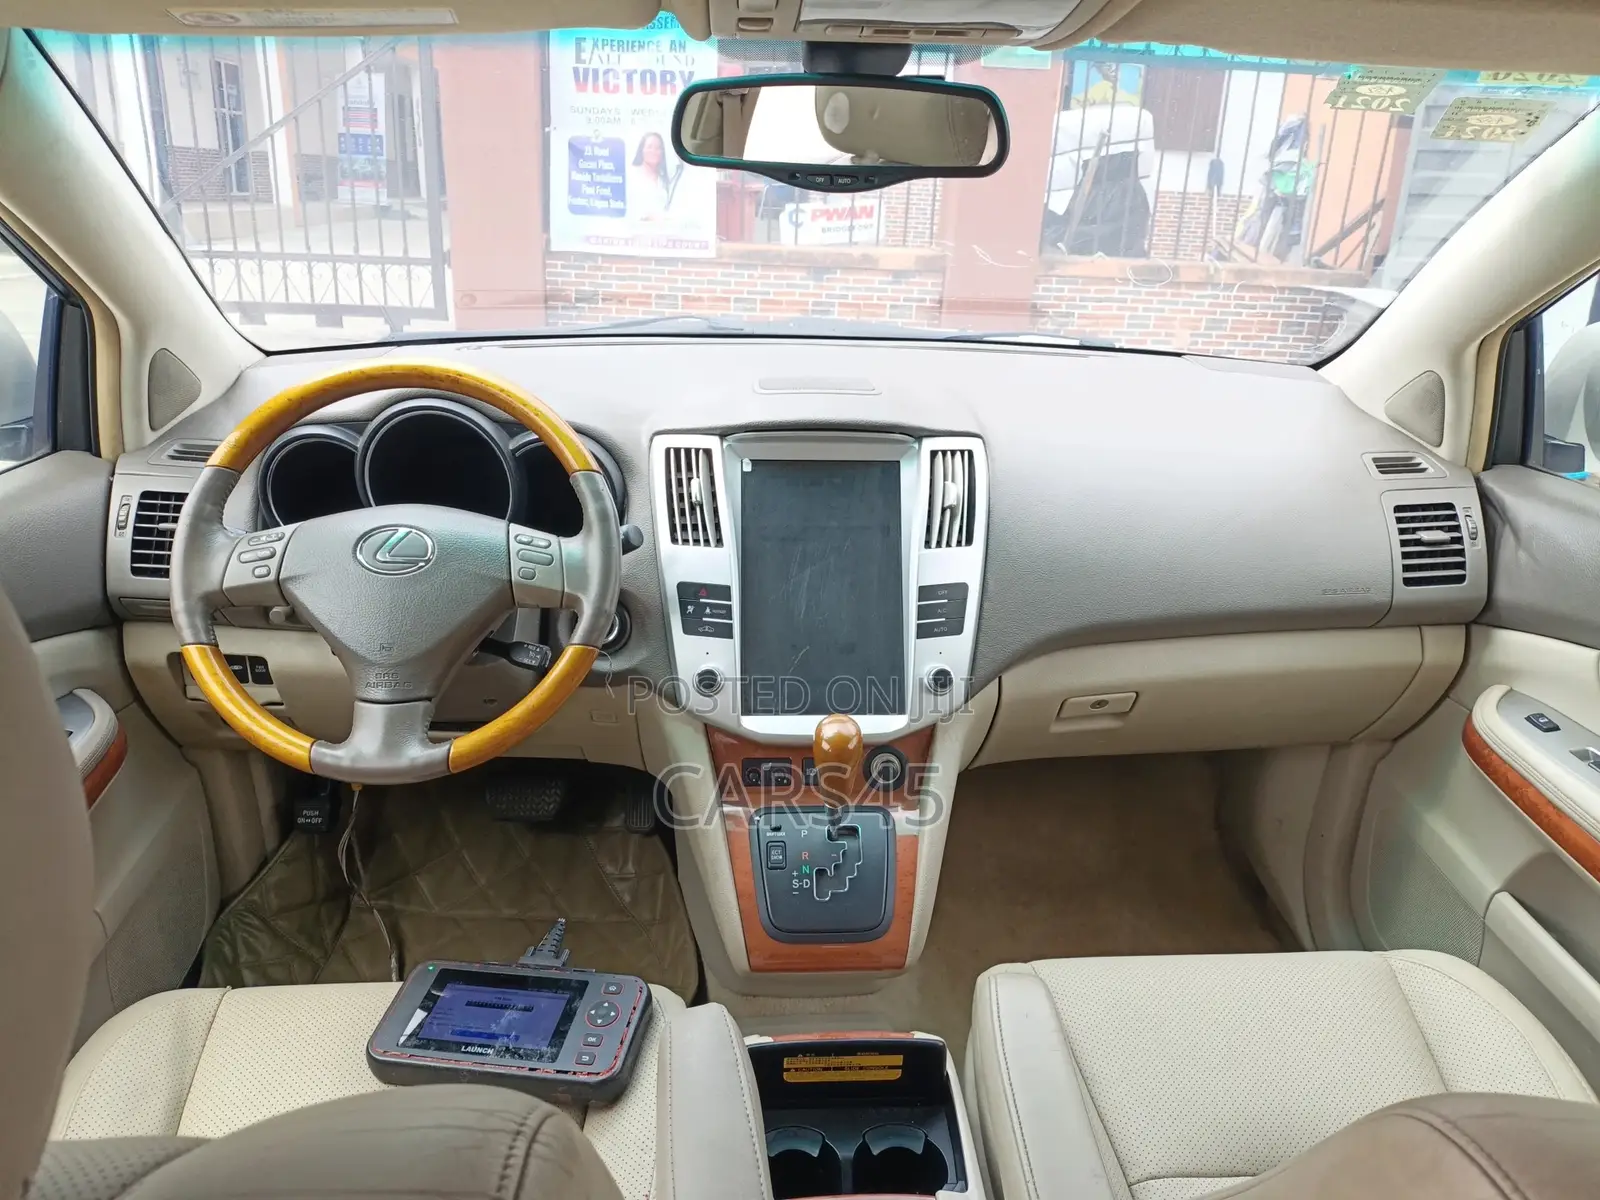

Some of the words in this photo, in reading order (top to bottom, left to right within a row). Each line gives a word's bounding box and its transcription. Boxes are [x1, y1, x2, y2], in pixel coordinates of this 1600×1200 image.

[574, 36, 662, 65] EXPERIENCE
[669, 39, 687, 54] AN
[572, 66, 696, 96] VICTORY
[570, 105, 622, 116] SUNDAYS
[810, 204, 875, 223] PWAN
[364, 680, 413, 690] AIRBAG
[801, 830, 808, 838] P
[802, 851, 809, 860] R
[802, 865, 810, 874] N
[461, 1045, 495, 1055] LAUNCH
